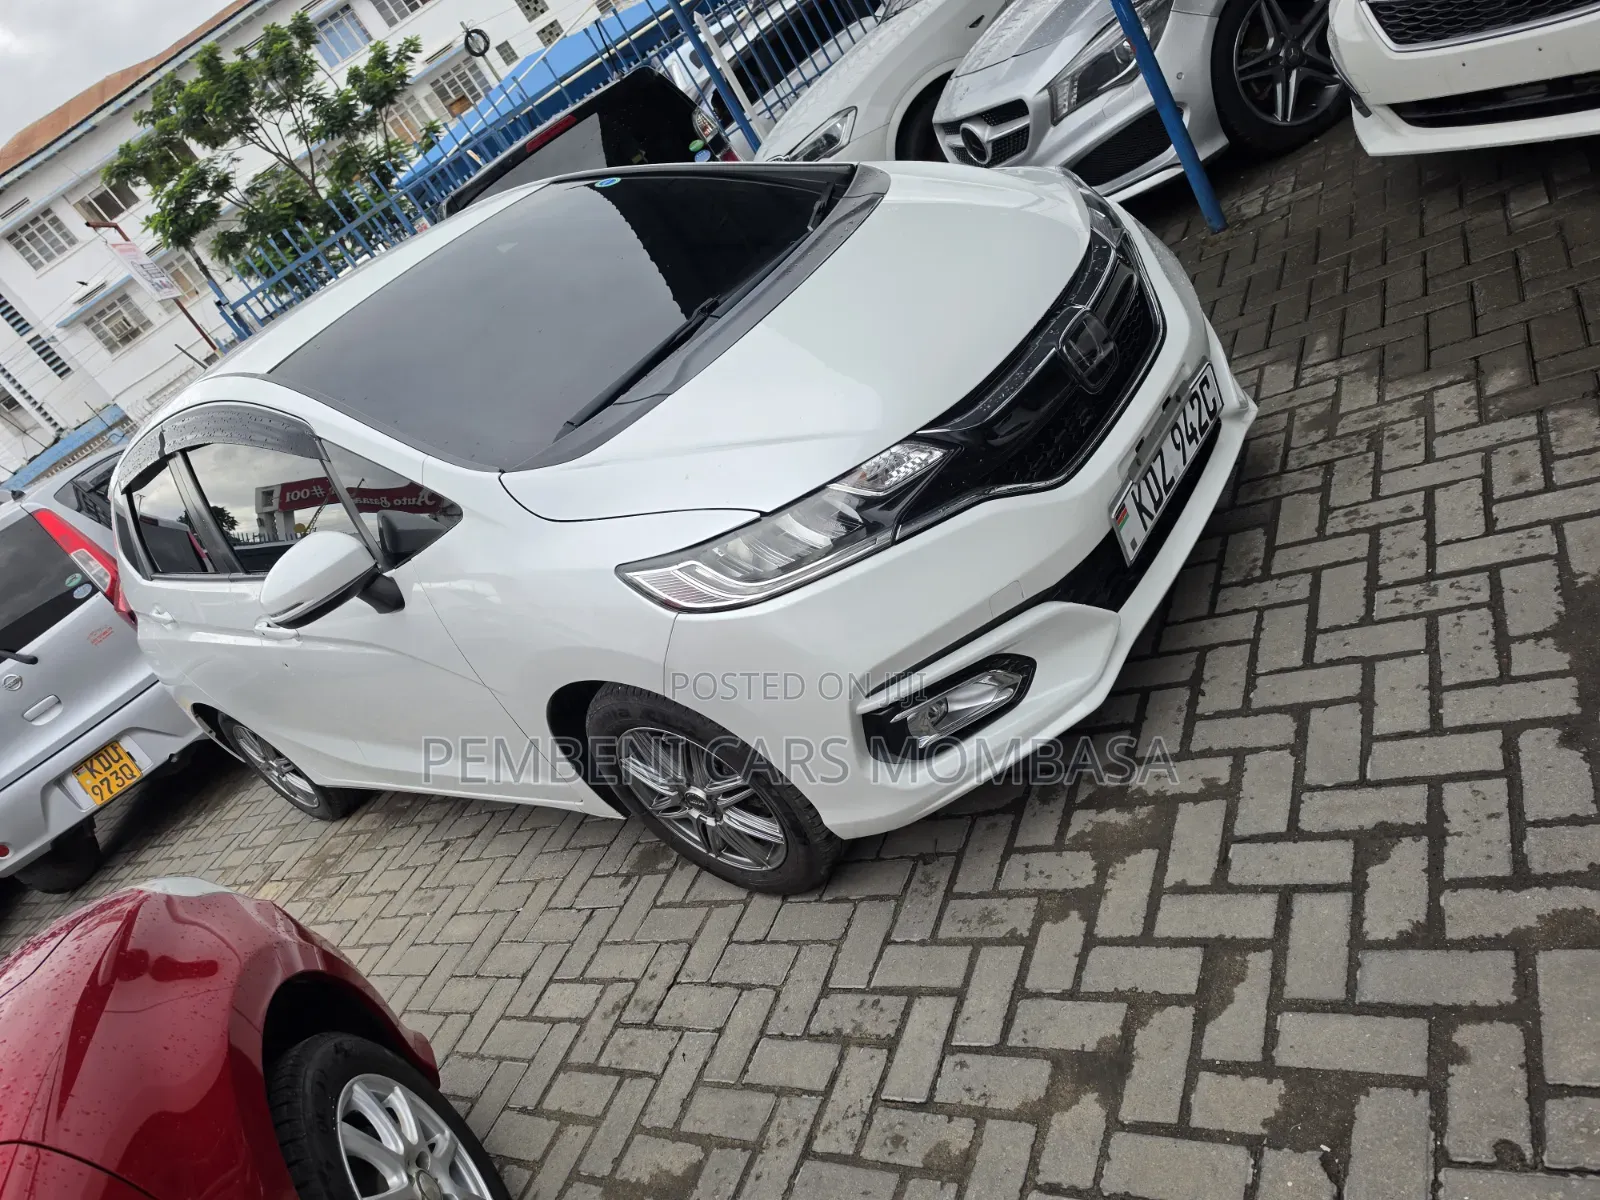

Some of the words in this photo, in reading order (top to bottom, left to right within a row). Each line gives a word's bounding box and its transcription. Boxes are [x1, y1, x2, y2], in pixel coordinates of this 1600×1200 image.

[1130, 448, 1175, 532] KDZ
[1170, 375, 1218, 466] 942C
[83, 745, 124, 780] KDU
[91, 763, 137, 801] 973Q
